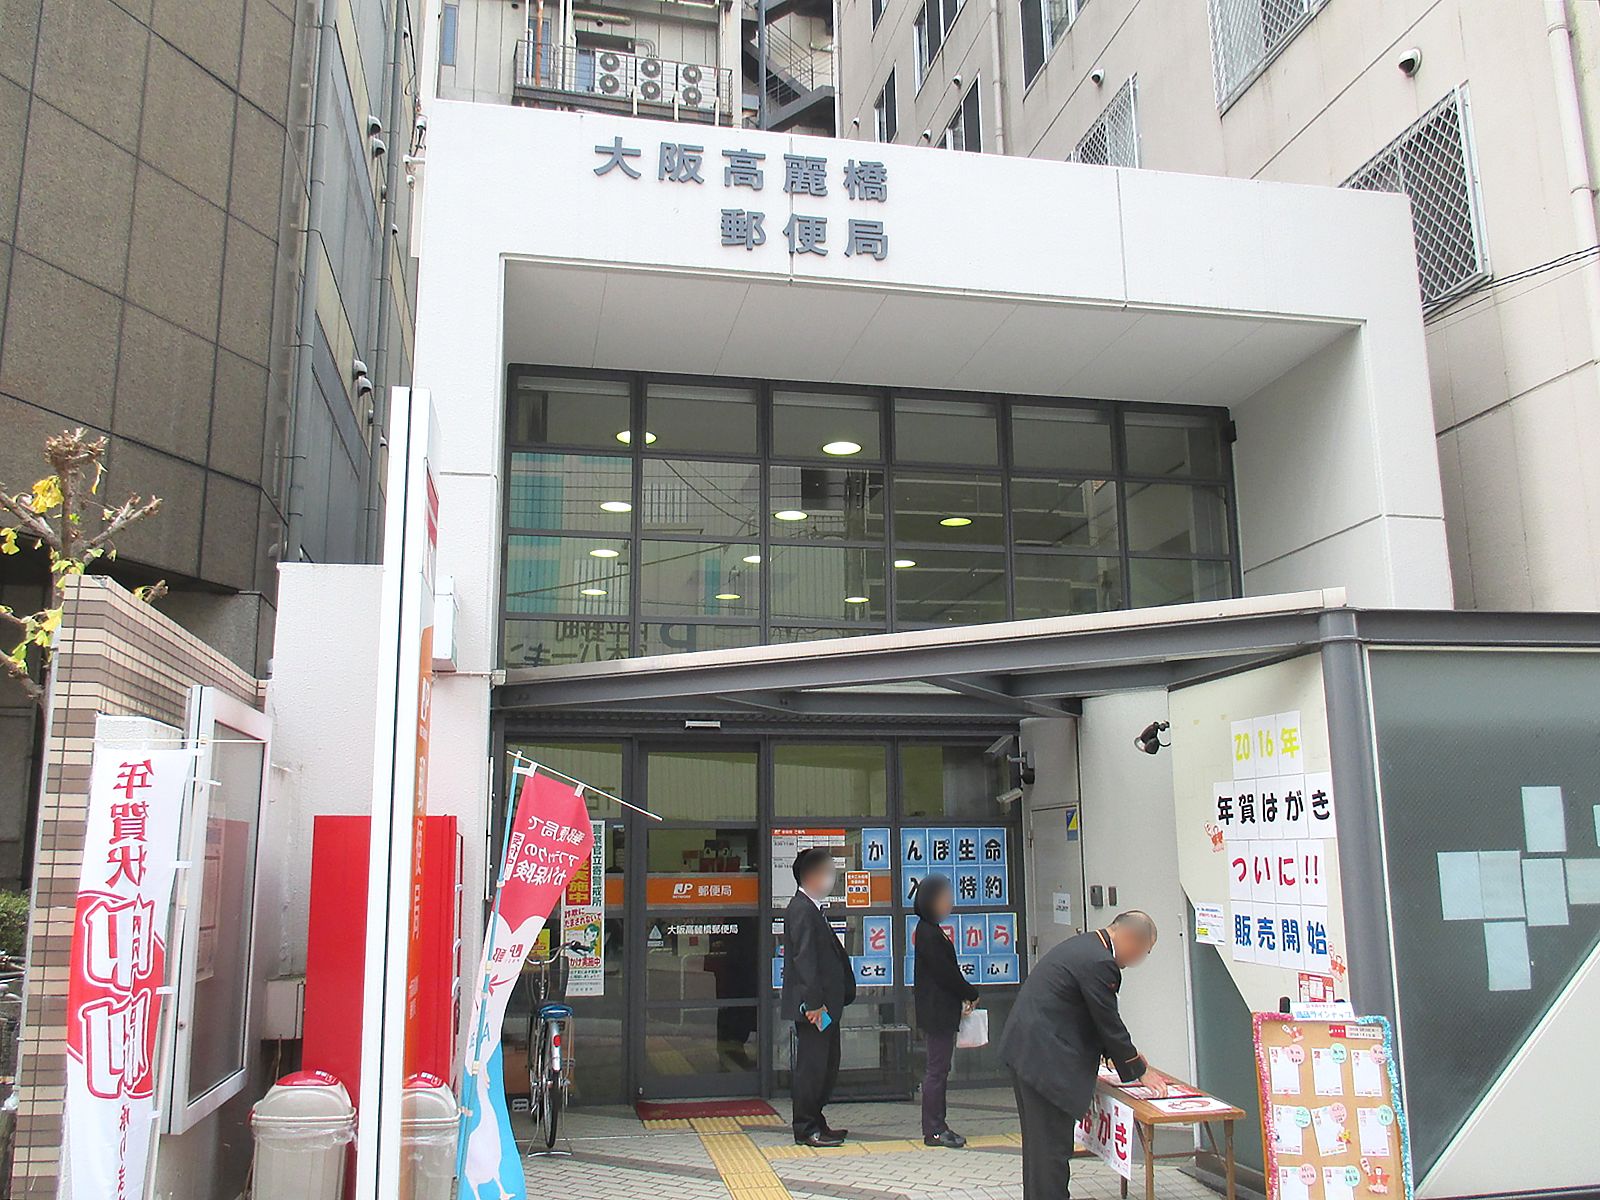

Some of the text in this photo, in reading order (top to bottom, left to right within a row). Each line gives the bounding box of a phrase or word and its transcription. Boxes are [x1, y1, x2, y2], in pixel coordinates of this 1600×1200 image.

[593, 136, 888, 202] 大阪高麗橋
[720, 208, 889, 260] 郵便局
[1234, 727, 1301, 761] 2016年
[1217, 789, 1331, 826] 年賀はがき
[868, 838, 1002, 862] かんぽ生命
[567, 859, 589, 903] 実施中
[1231, 854, 1319, 886] ついに!!
[698, 884, 732, 897] 郵便局
[667, 924, 739, 935] 大阪高麗橋郵便局
[1234, 913, 1328, 955] 販売開始
[958, 963, 1009, 976] 安心!
